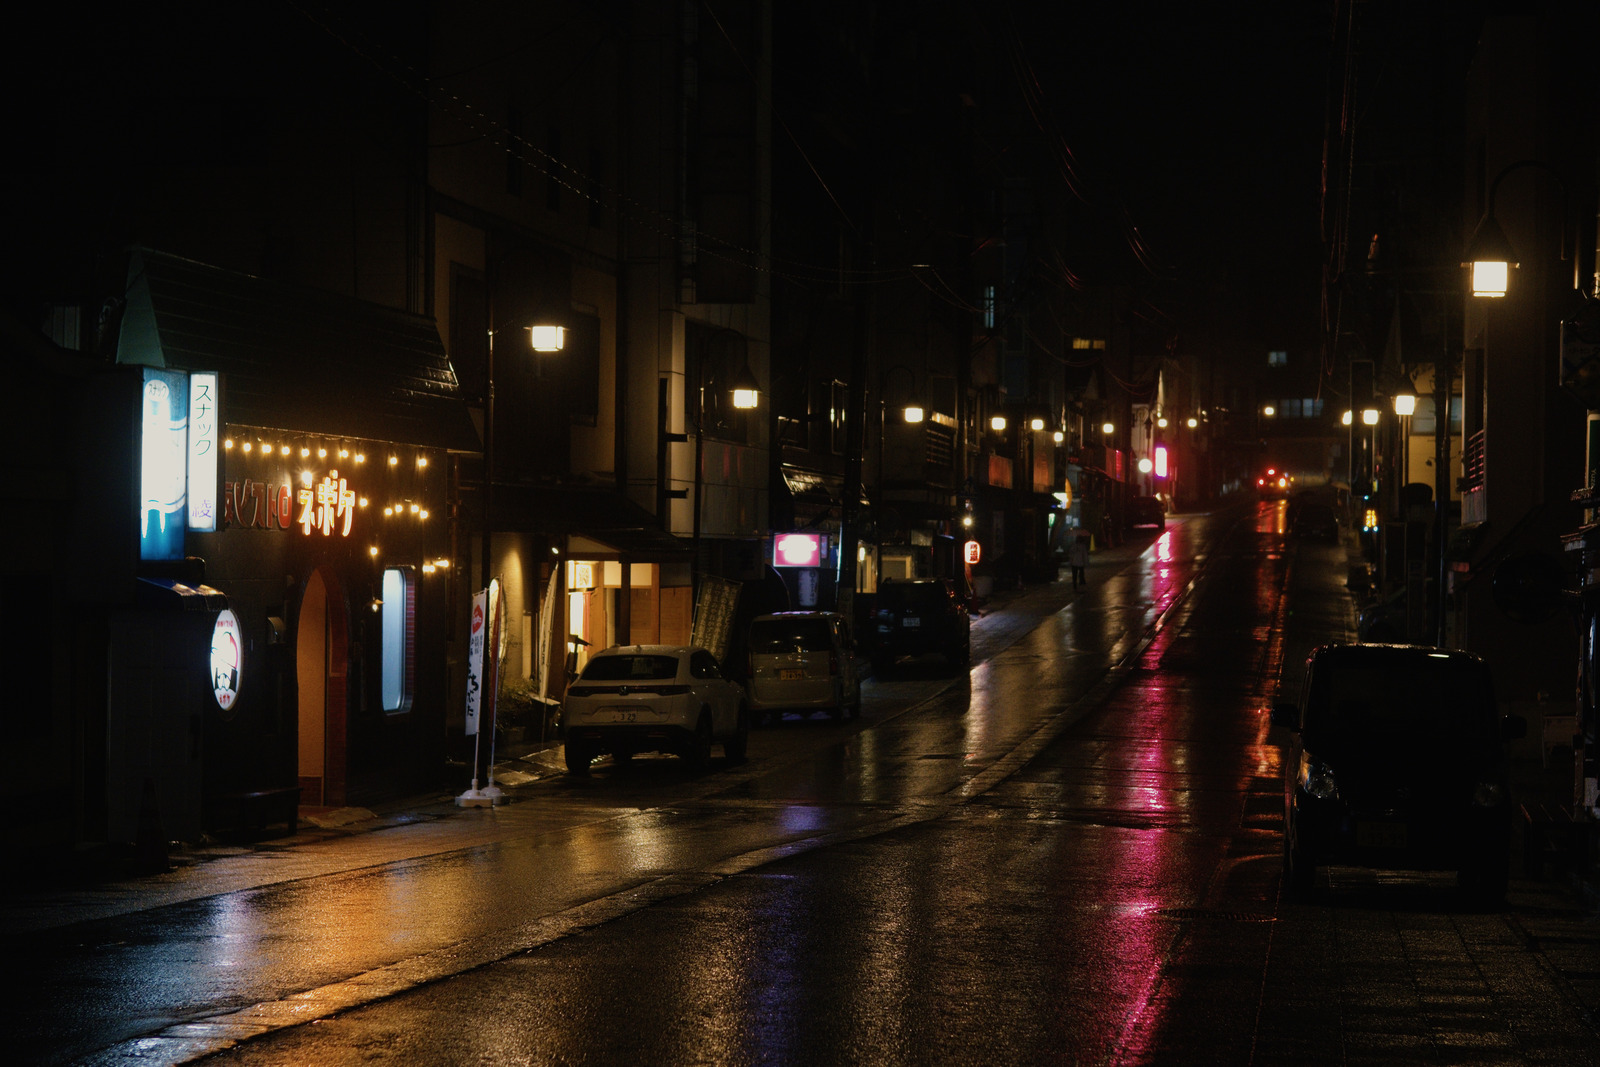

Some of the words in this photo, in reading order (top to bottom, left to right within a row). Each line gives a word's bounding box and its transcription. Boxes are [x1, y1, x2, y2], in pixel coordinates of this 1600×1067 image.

[195, 385, 212, 456] スナック
[296, 469, 356, 538] ネボケ
